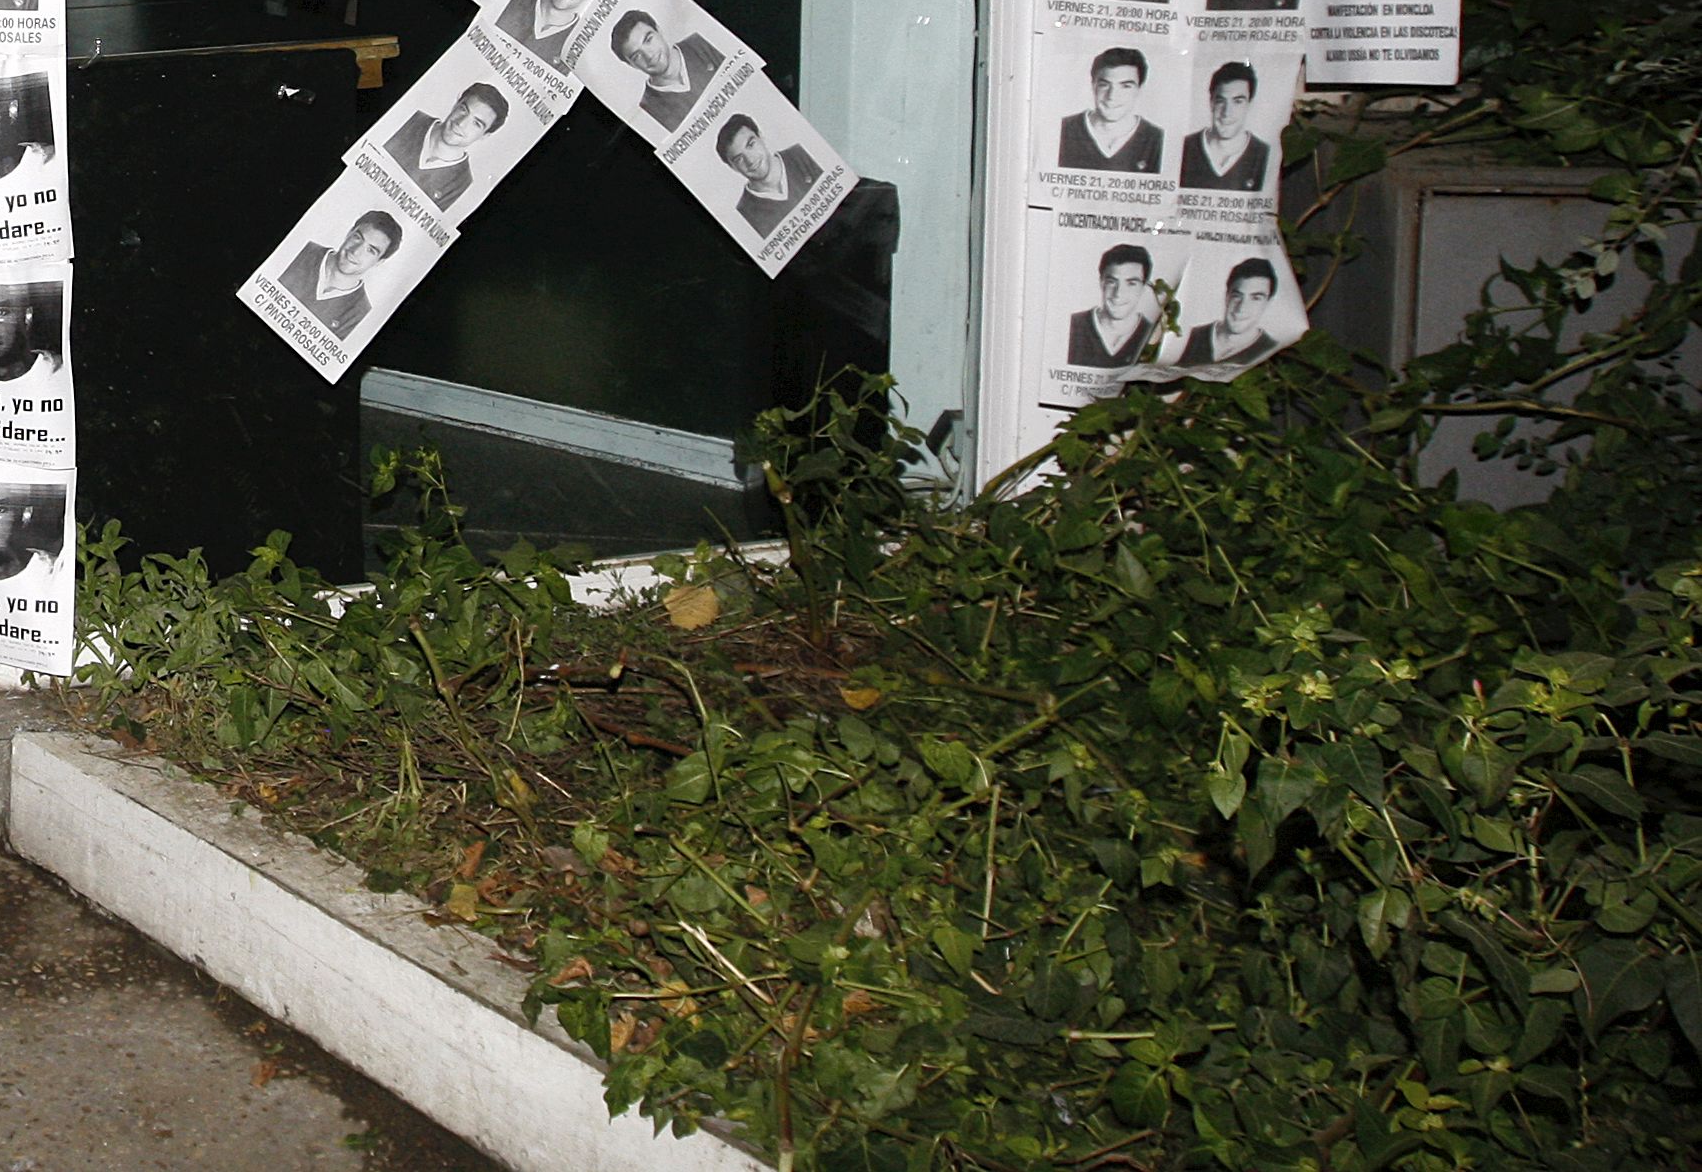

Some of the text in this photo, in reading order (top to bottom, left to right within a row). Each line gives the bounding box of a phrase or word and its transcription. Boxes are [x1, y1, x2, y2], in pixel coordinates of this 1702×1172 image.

[1039, 172, 1175, 191] VIERNES 21, 20:00 HORAS
[5, 192, 27, 210] yo
[35, 189, 56, 205] no
[1052, 187, 1161, 204] C/ PINTOR ROSALES
[255, 274, 348, 363] VIERNES 21, 20:00 HORAS
[255, 294, 330, 365] C/ PINTOR ROSALES
[13, 398, 33, 414] yo
[41, 398, 62, 412] no
[7, 596, 28, 614] yo
[35, 598, 58, 613] no
